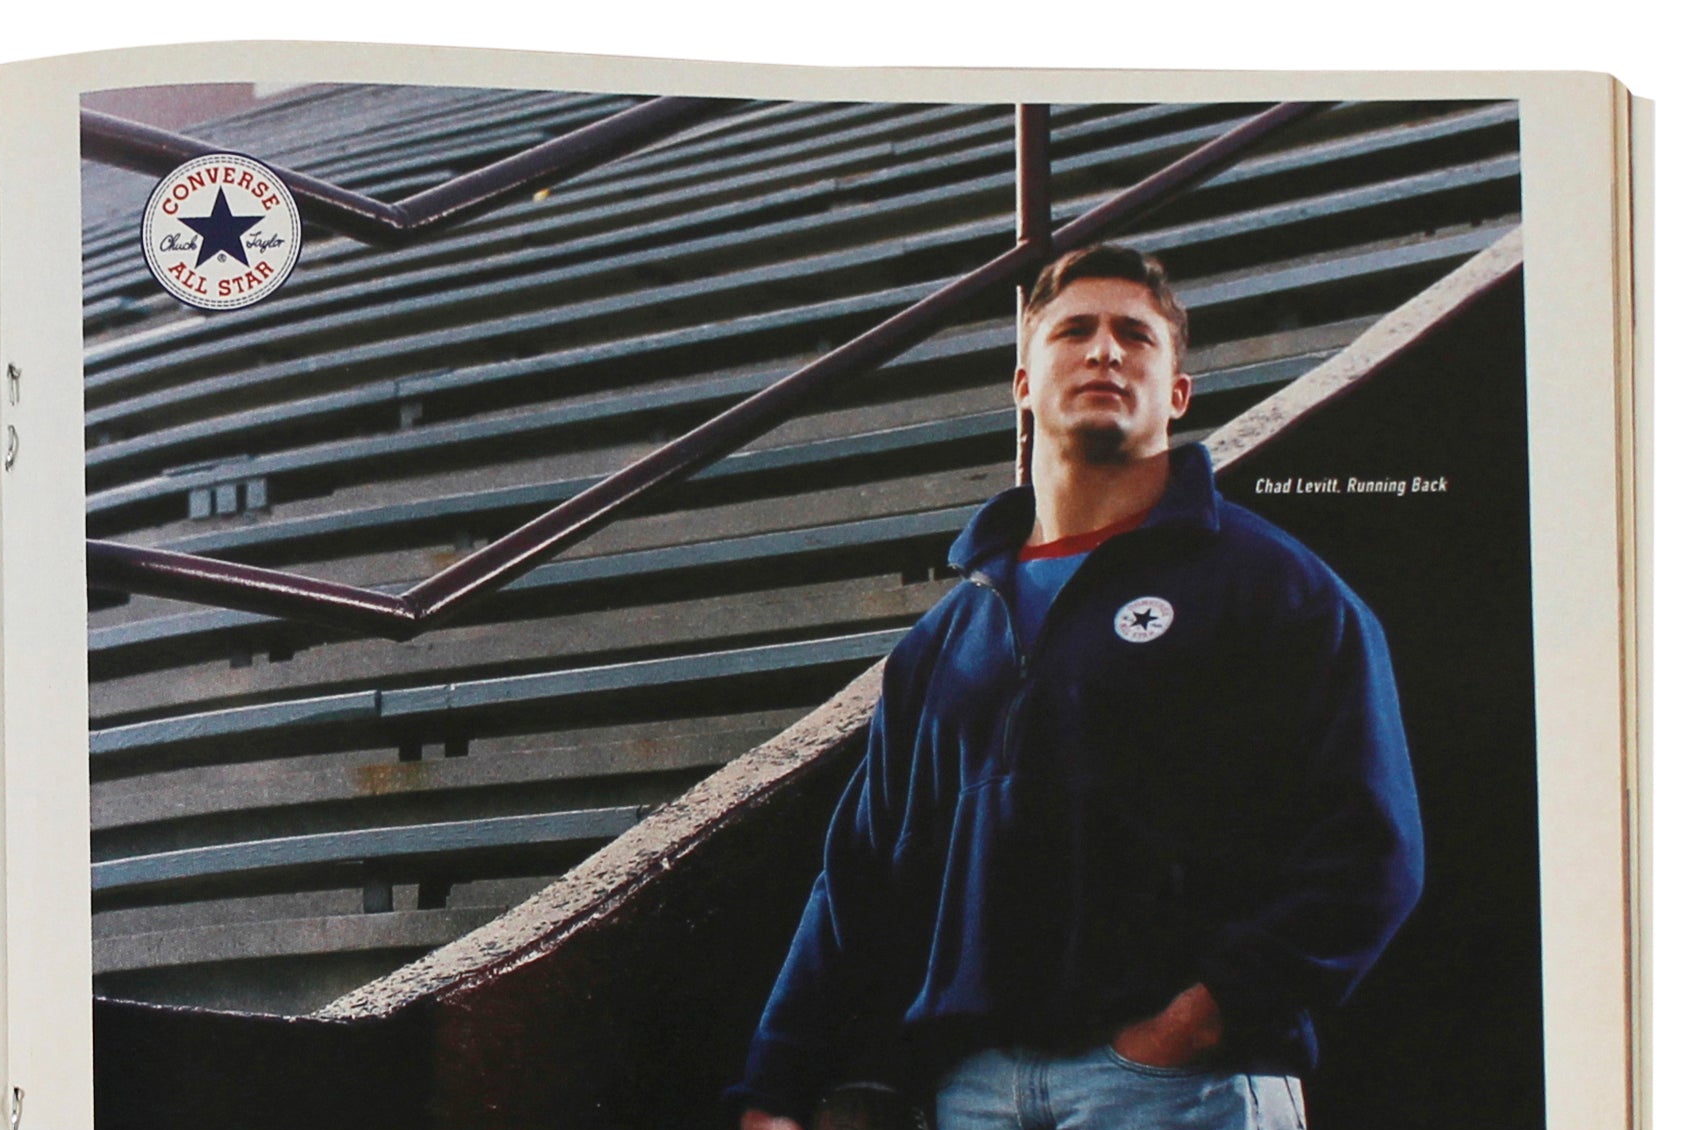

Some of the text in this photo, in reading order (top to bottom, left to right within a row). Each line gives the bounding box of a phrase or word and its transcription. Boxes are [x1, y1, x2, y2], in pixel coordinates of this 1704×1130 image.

[162, 167, 280, 215] CONVERSE
[160, 231, 285, 254] Chuck Taylor
[168, 261, 275, 296] ALL STAR
[1256, 478, 1292, 493] Chad
[1347, 477, 1406, 496] Running
[1412, 477, 1447, 492] Back
